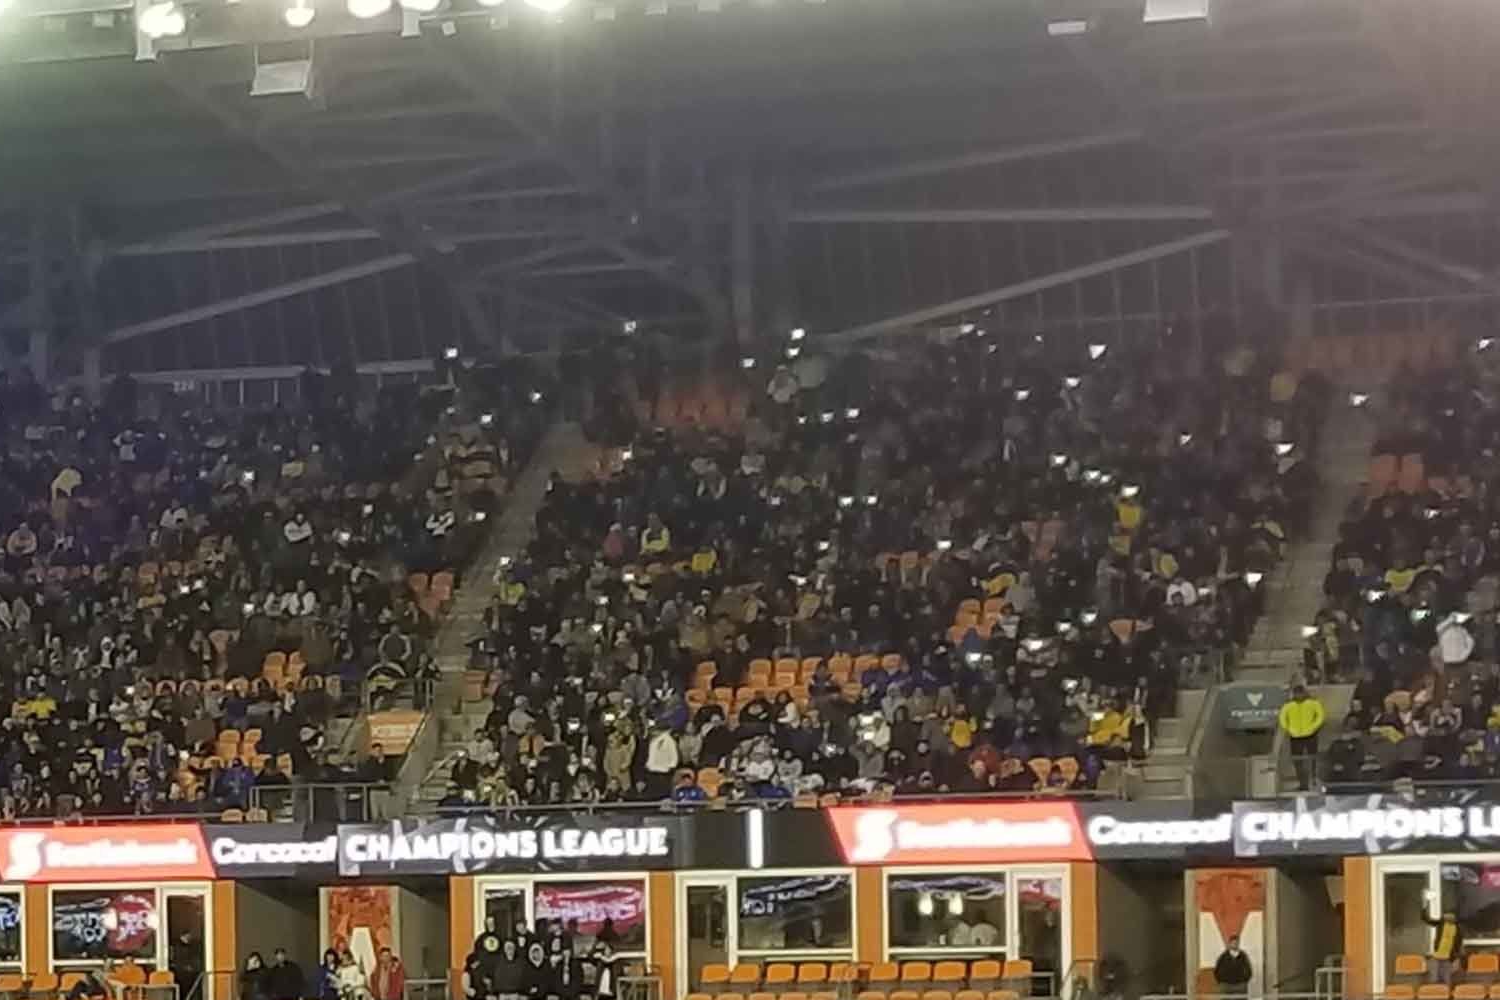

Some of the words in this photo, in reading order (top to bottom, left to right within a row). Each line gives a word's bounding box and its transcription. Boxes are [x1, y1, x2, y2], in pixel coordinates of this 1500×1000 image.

[1241, 806, 1465, 841] CHAMPIONS
[346, 831, 538, 861] CHAMPIONS
[542, 827, 669, 857] LEAGUE
